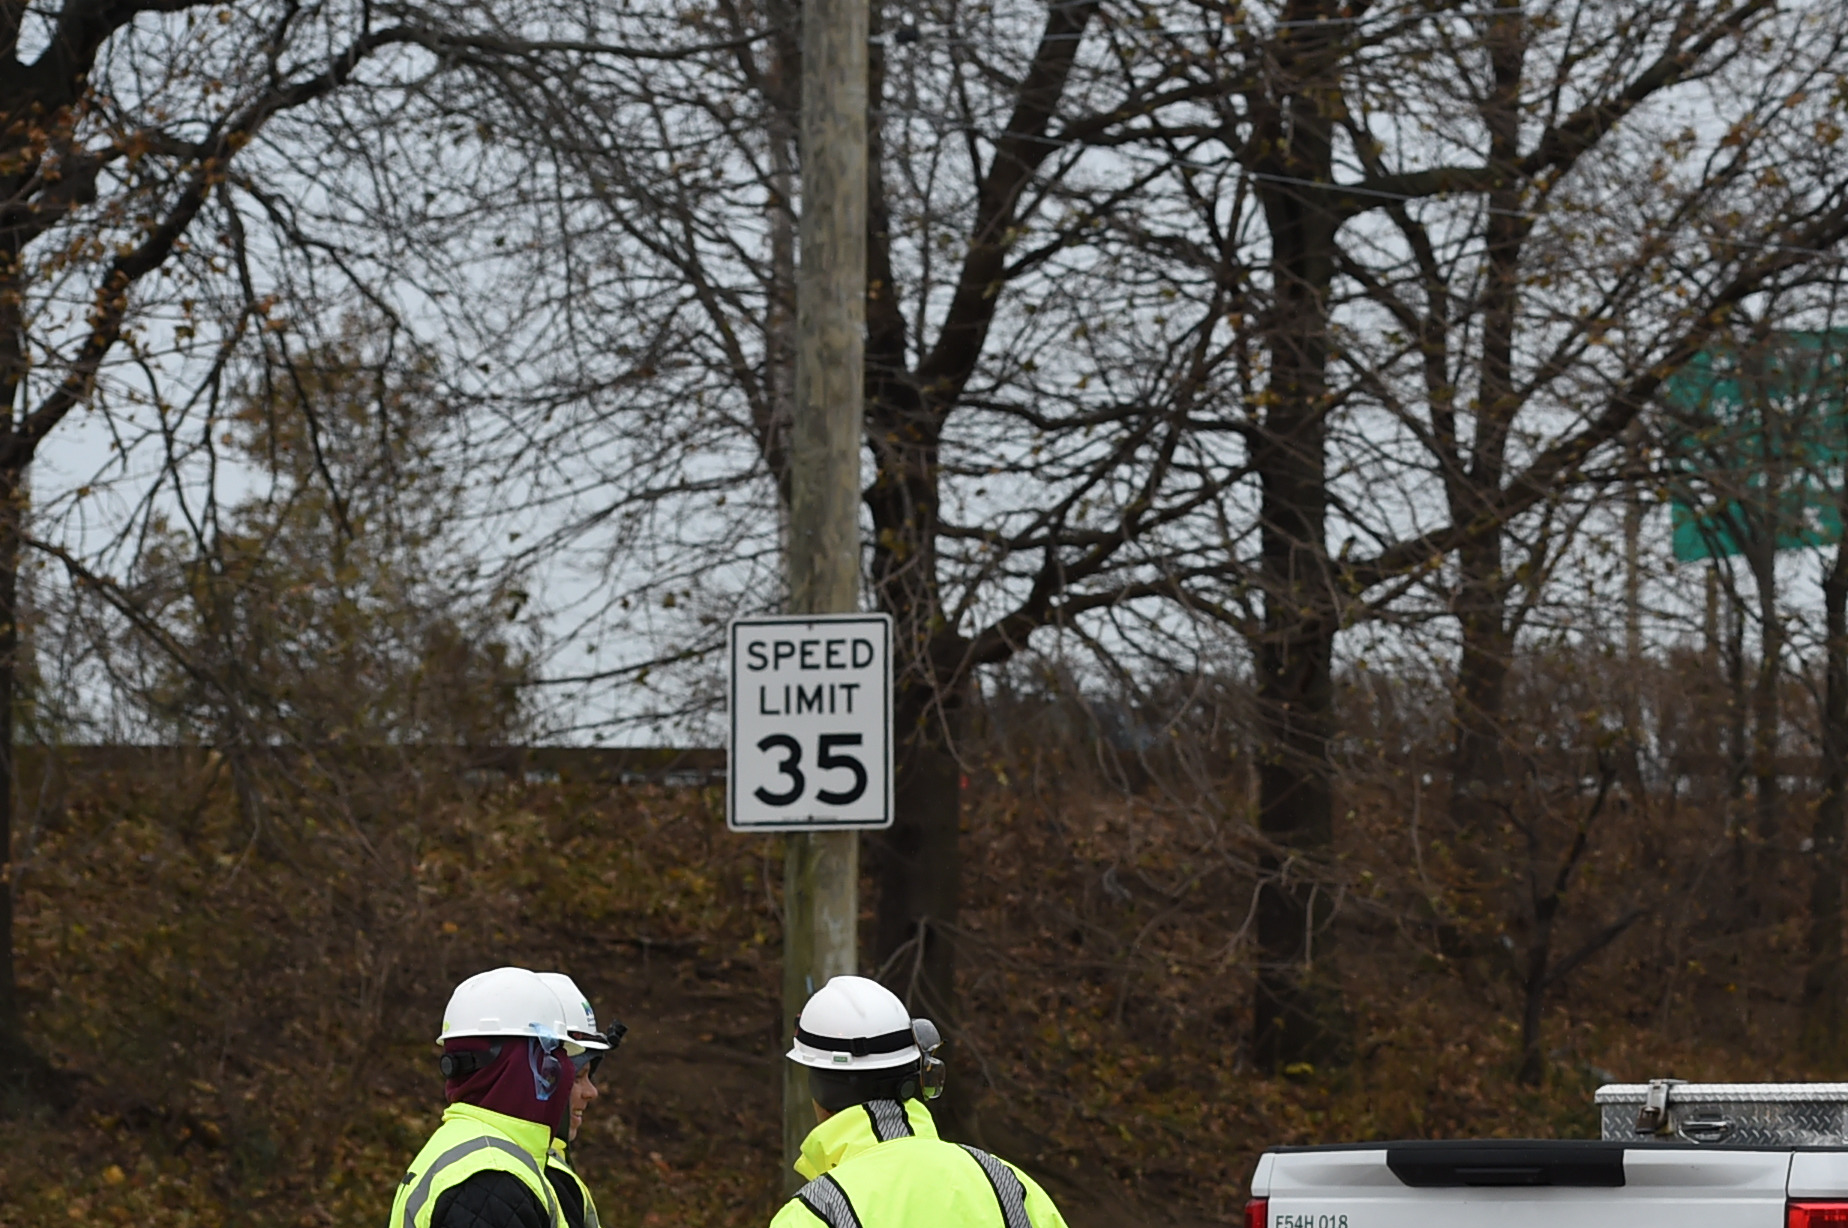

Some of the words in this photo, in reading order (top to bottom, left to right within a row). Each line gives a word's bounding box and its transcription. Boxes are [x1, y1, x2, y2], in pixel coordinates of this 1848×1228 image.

[747, 638, 874, 671] SPEED
[760, 683, 861, 715] LIMIT
[754, 733, 868, 807] 35
